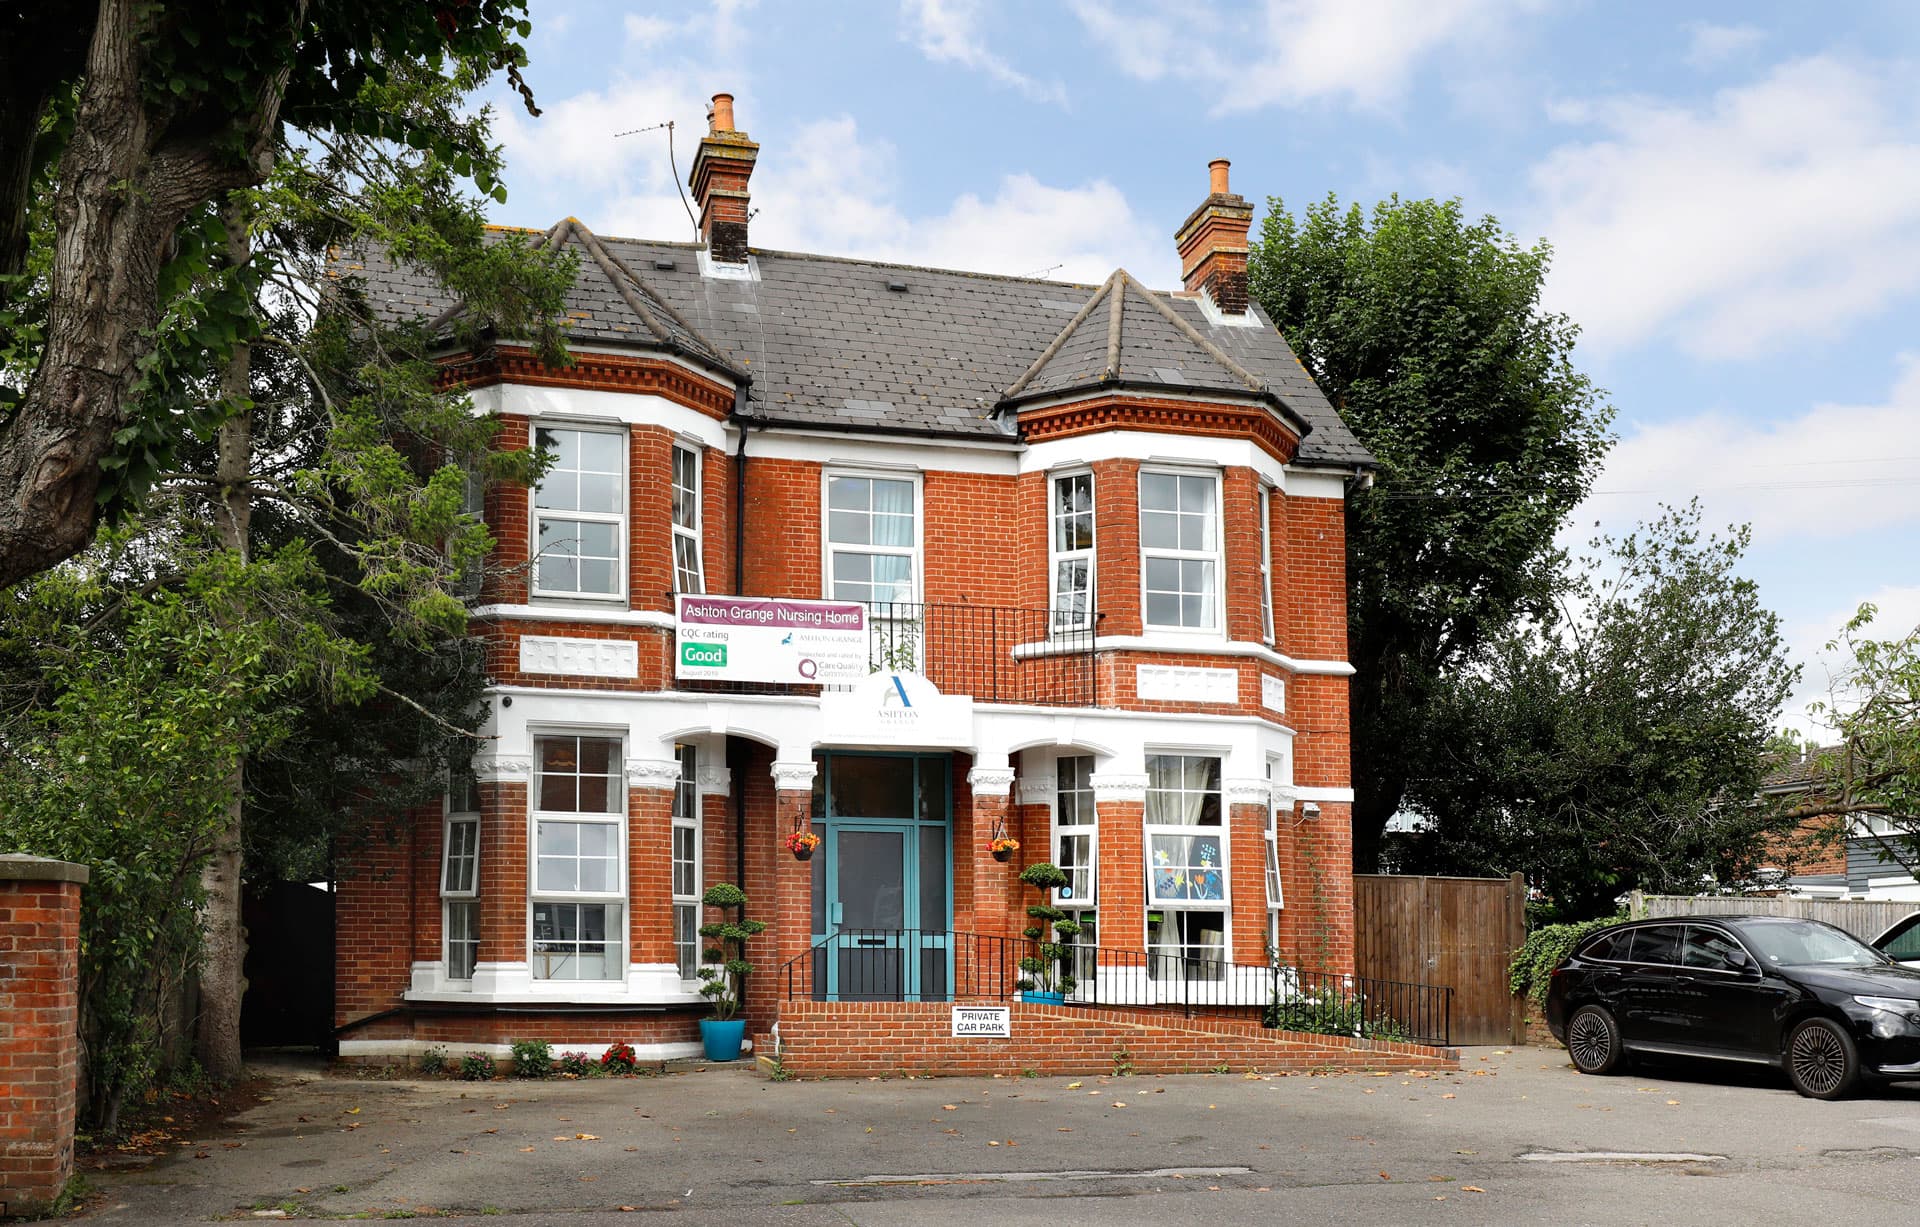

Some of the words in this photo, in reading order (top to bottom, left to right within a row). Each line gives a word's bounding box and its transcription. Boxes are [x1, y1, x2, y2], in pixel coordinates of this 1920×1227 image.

[685, 604, 727, 618] Ashton
[730, 606, 774, 623] Grange
[777, 608, 822, 625] Nursing
[825, 610, 860, 624] Home
[681, 628, 701, 639] CQC
[703, 630, 729, 642] rating
[685, 647, 722, 662] Good
[818, 661, 836, 670] Care
[836, 662, 864, 673] Quality
[818, 669, 864, 678] Commission
[877, 709, 920, 719] ASHTON
[961, 1012, 1001, 1021] PRIVATE
[957, 1023, 977, 1031] CAR
[979, 1023, 1005, 1031] PARK
